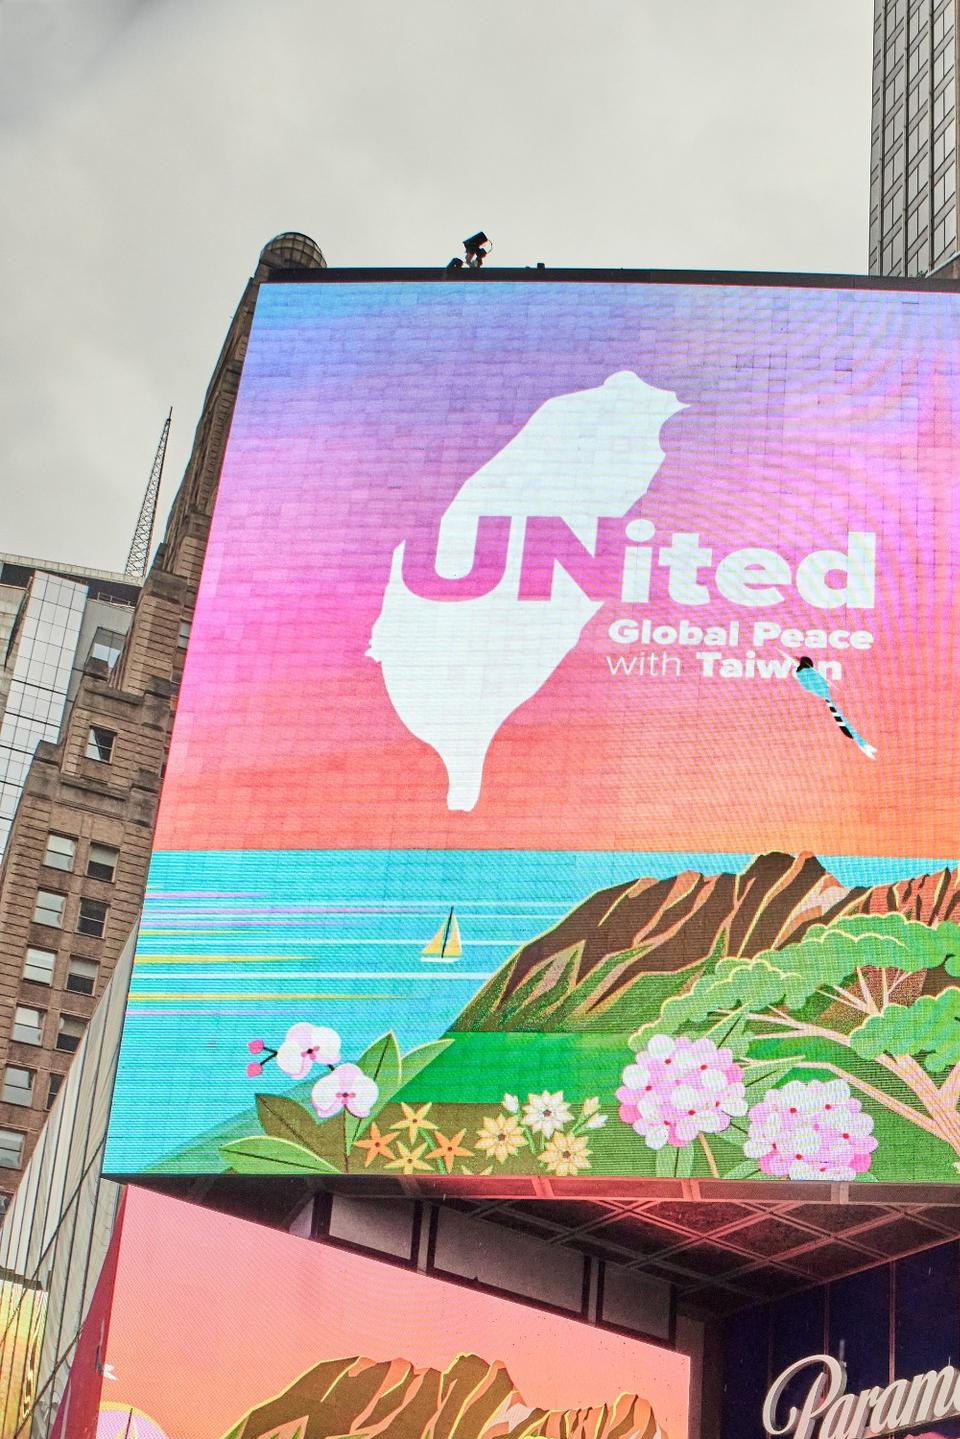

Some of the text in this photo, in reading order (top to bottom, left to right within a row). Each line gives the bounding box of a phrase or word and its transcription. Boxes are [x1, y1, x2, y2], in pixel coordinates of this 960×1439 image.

[401, 514, 876, 609] UNited
[607, 617, 875, 650] Global Peace
[605, 650, 843, 681] with Taiwn
